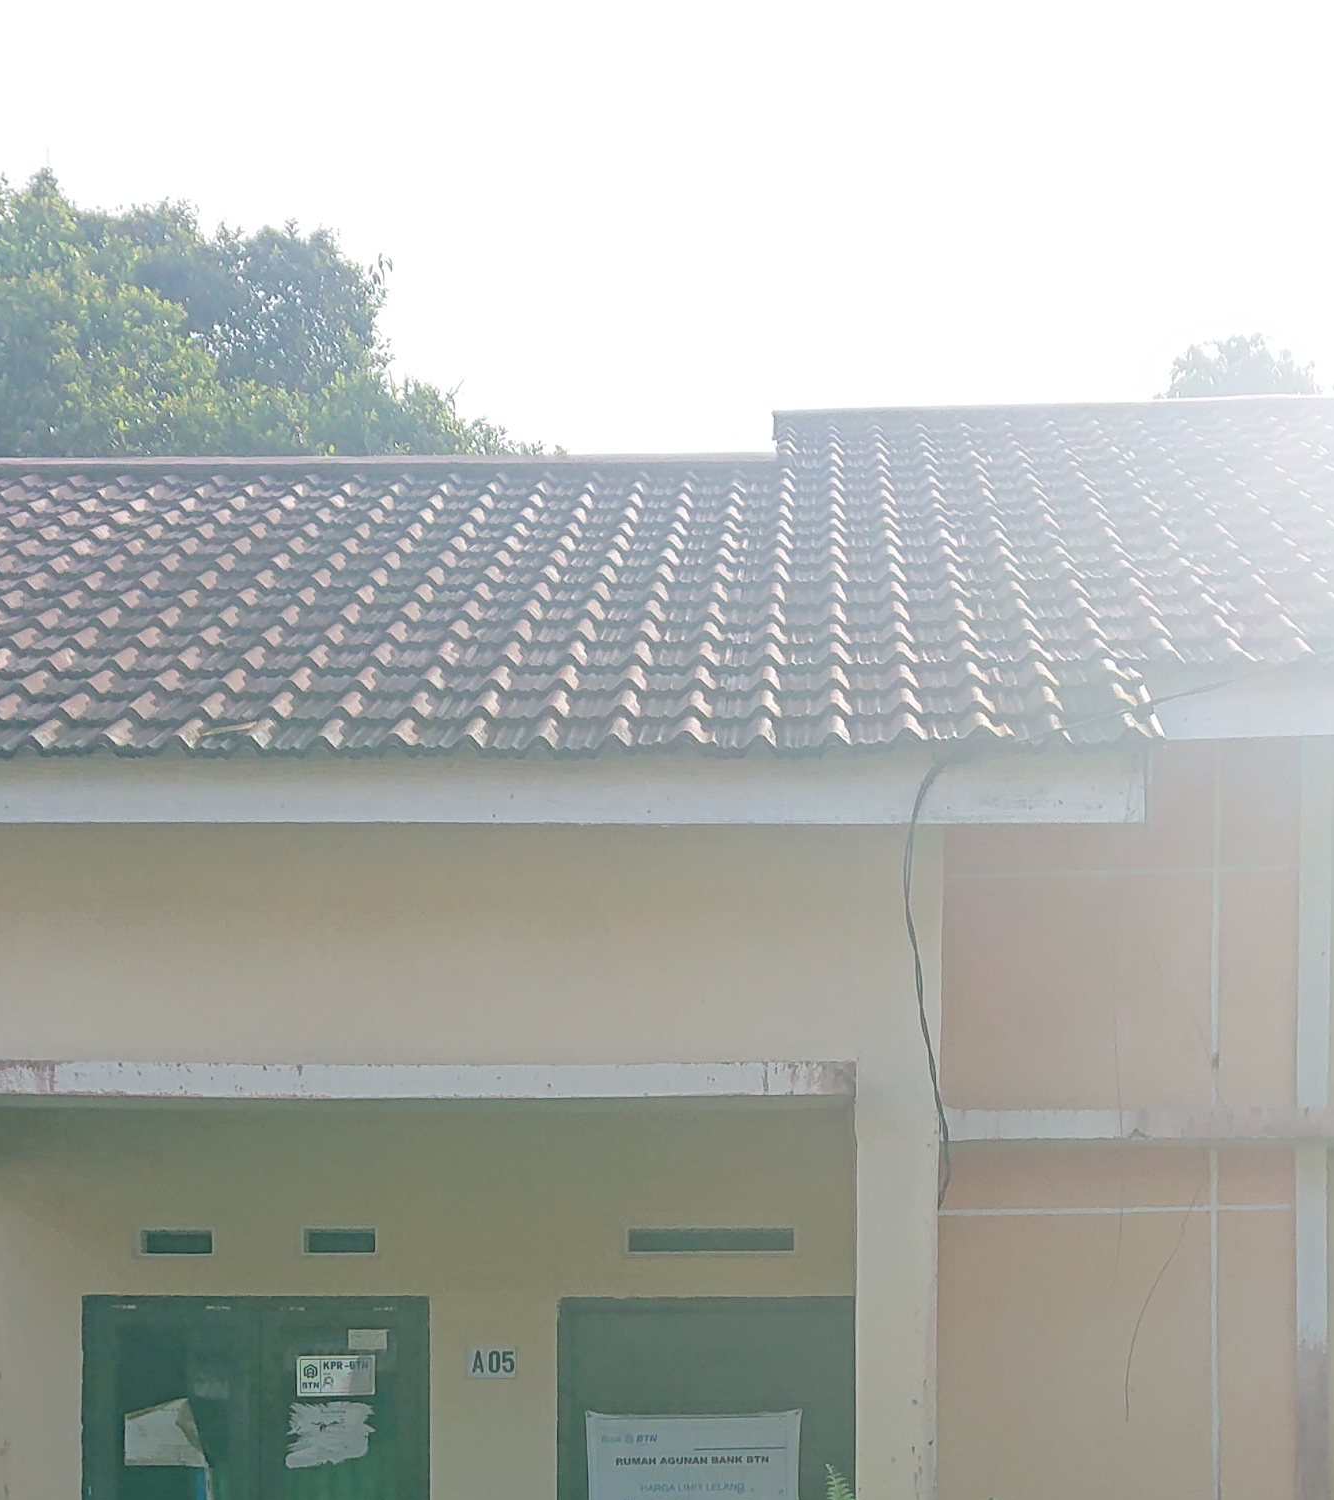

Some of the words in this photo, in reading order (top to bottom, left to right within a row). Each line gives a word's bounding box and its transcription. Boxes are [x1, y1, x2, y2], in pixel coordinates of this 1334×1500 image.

[636, 1434, 658, 1443] BTN
[615, 1457, 656, 1466] RUMAH
[659, 1456, 708, 1465] AGUNAN
[711, 1456, 743, 1464] BANK
[746, 1455, 769, 1464] BTN
[640, 1483, 675, 1492] HARGA
